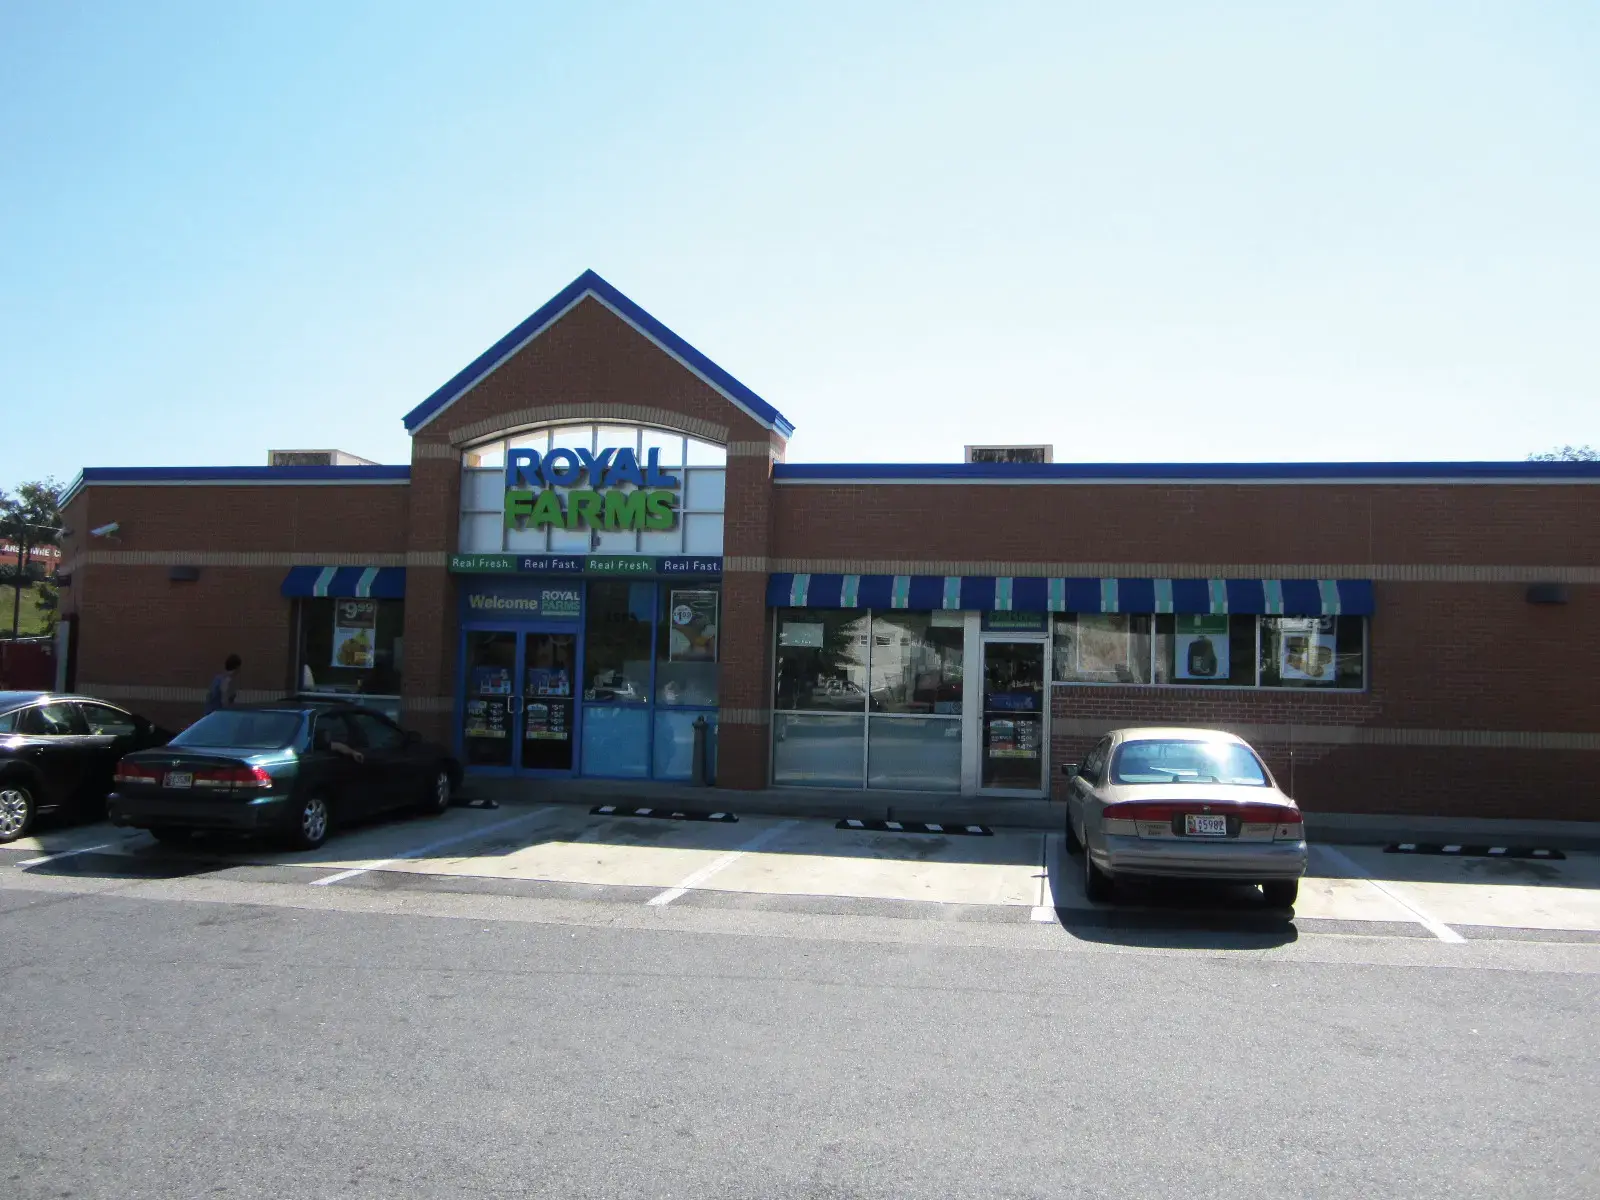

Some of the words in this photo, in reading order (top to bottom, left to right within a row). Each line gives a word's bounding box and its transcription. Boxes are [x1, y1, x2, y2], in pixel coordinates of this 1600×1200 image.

[507, 447, 678, 487] ROYAL
[505, 490, 676, 530] FARMS
[452, 558, 475, 568] Real
[479, 558, 512, 568] Fresh.
[524, 559, 548, 569] Real
[552, 559, 579, 569] Fast.
[589, 560, 614, 570] Real
[618, 560, 652, 570] Fresh.
[664, 560, 689, 571] Real
[693, 561, 721, 571] Fast.
[542, 590, 580, 601] ROYAL
[469, 594, 538, 610] Welcome
[542, 600, 580, 610] FARMS
